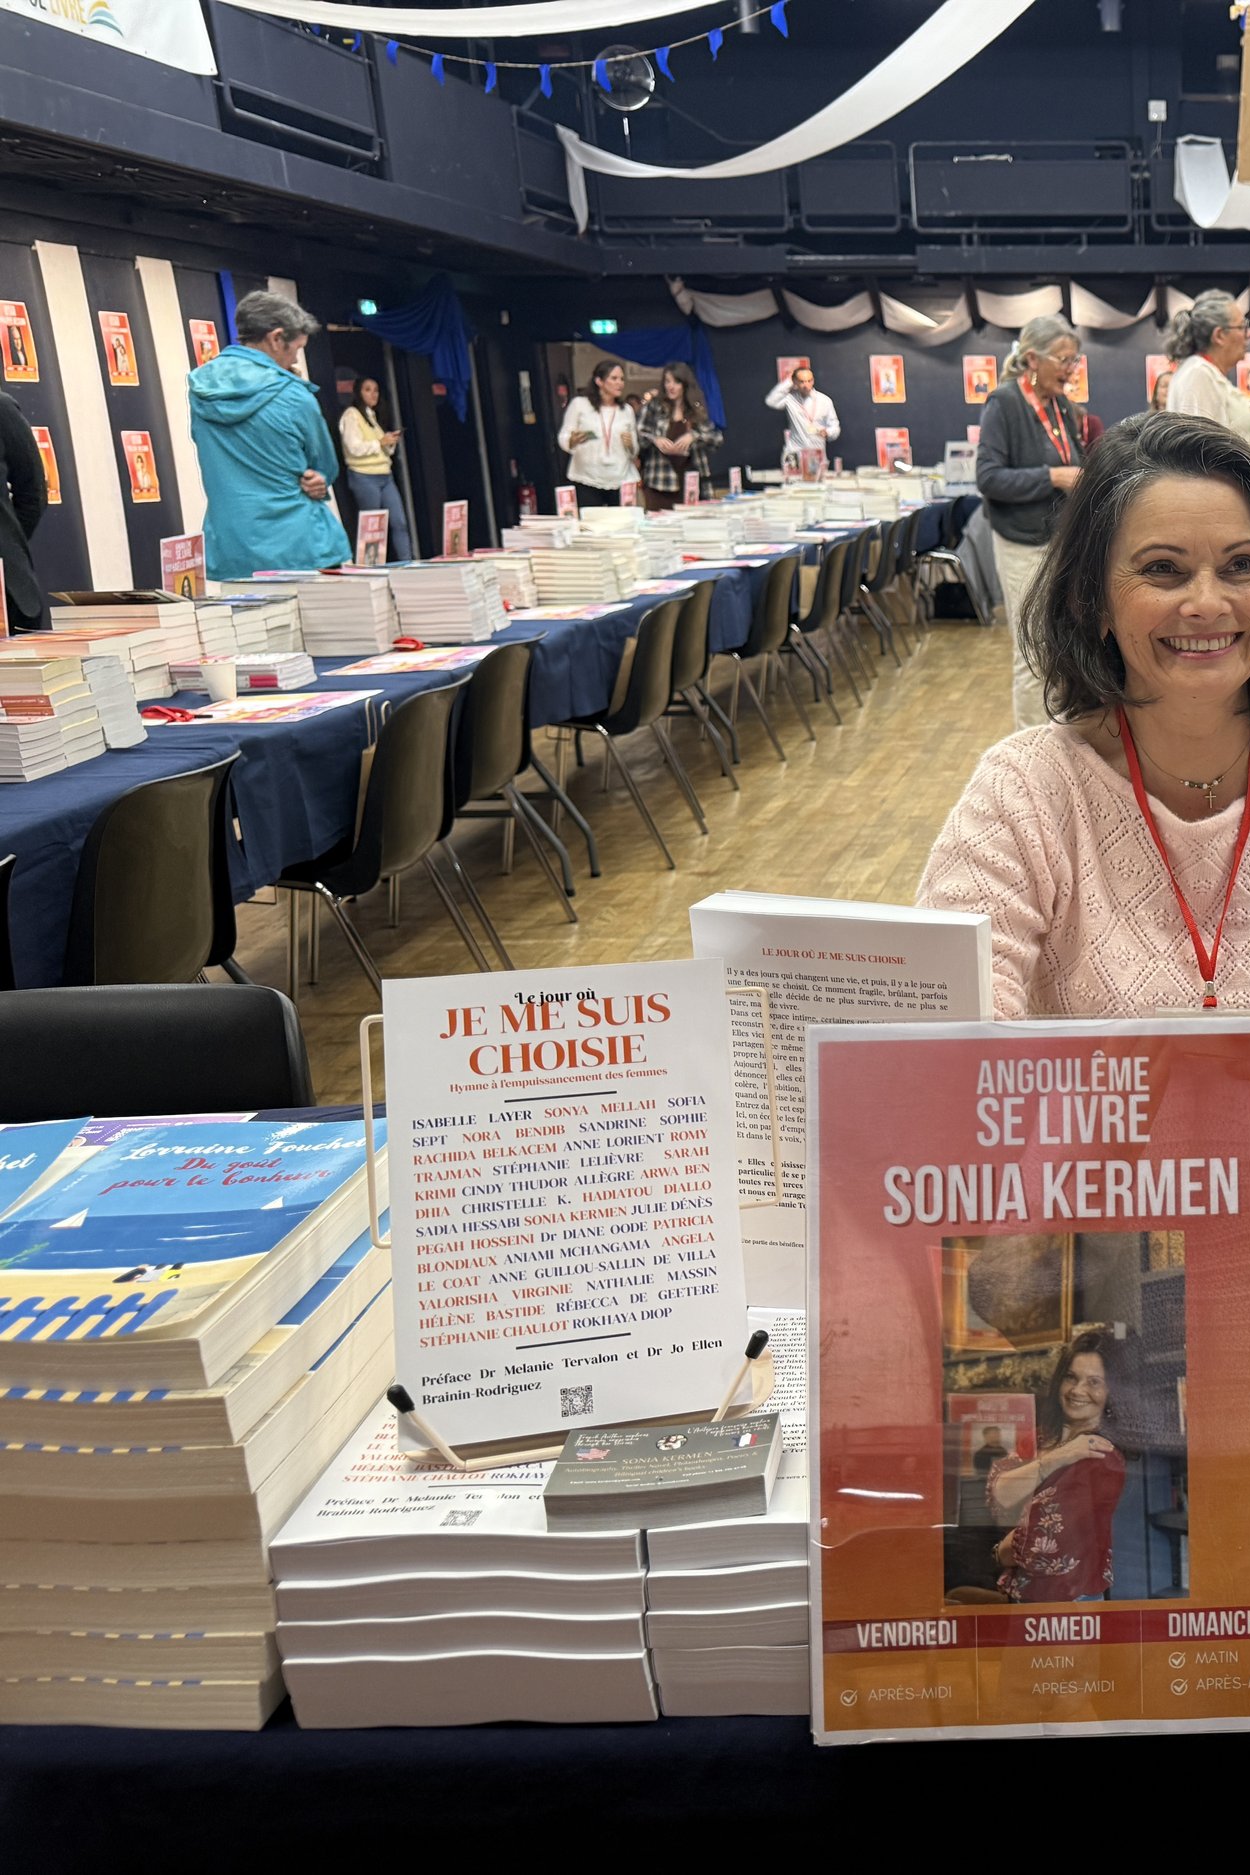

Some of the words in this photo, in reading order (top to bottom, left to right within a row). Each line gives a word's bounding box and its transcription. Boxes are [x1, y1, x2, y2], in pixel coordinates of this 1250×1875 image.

[762, 948, 774, 957] LE
[775, 948, 800, 959] JOUR
[802, 949, 815, 959] OÙ
[817, 951, 828, 960] JE
[830, 952, 844, 961] ME
[845, 953, 866, 962] SUIS
[868, 955, 906, 964] CHOISIE
[515, 991, 536, 1005] Le
[537, 990, 572, 1007] jour
[576, 988, 595, 1001] où
[744, 980, 769, 988] femme
[783, 982, 808, 990] choisit.
[825, 986, 856, 994] moment
[859, 987, 886, 997] fragile,
[888, 988, 917, 999] brûlant,
[921, 991, 948, 1000] parfois
[786, 992, 810, 1001] décide
[813, 994, 822, 1002] de
[838, 996, 854, 1005] plus
[858, 999, 891, 1008] survivre,
[894, 1000, 903, 1008] de
[920, 1001, 936, 1010] plus
[440, 1007, 487, 1039] JE
[501, 1002, 565, 1034] ME
[578, 993, 670, 1028] SUIS
[469, 1034, 647, 1076] CHOISIE
[450, 1080, 489, 1094] Hymne
[492, 1079, 498, 1089] à
[500, 1072, 602, 1089] l'empuissancement
[605, 1070, 623, 1081] des
[626, 1067, 668, 1079] femmes
[976, 1050, 1150, 1095] ANGOULÊME
[412, 1114, 476, 1130] ISABELLE
[489, 1110, 532, 1124] LAYER
[544, 1105, 588, 1118] SONYA
[601, 1100, 656, 1113] MELLAH
[668, 1095, 705, 1108] SOFIA
[976, 1096, 1025, 1147] SE
[1039, 1094, 1151, 1144] LIVRE
[413, 1135, 447, 1148] SEPT
[462, 1130, 501, 1144] NORA
[516, 1124, 565, 1138] BENDIB
[579, 1118, 646, 1133] SANDRINE
[660, 1112, 707, 1126] SOPHIE
[120, 1142, 258, 1160] Lorraine
[263, 1136, 366, 1155] Fouchet
[414, 1150, 476, 1165] RACHIDA
[483, 1143, 557, 1159] BELKACEM
[563, 1138, 600, 1152] ANNE
[607, 1133, 664, 1148] LORIENT
[670, 1129, 708, 1142] ROMY
[173, 1158, 217, 1171] Du
[98, 1178, 177, 1196] pour
[187, 1172, 212, 1186] le
[220, 1168, 331, 1188] bonheur
[883, 1162, 1028, 1225] SONIA
[1043, 1157, 1240, 1219] KERMEN
[416, 1224, 458, 1238] SADIA
[462, 1218, 520, 1233] HESSABI
[524, 1213, 566, 1228] SONIA
[570, 1206, 627, 1222] KERMEN
[631, 1201, 667, 1215] JULIE
[671, 1196, 712, 1211] DÉNÈS
[419, 1311, 475, 1329] HÉLÈNE
[486, 1305, 545, 1321] BASTIDE
[556, 1296, 619, 1313] RÉBECCA
[630, 1291, 647, 1304] DE
[658, 1283, 718, 1300] GEETERE
[419, 1328, 500, 1349] STÉPHANIE
[503, 1320, 569, 1338] CHAULOT
[572, 1313, 637, 1329] ROKHAYA
[641, 1308, 672, 1321] DIOP
[422, 1371, 471, 1387] Préface
[480, 1368, 496, 1379] Dr
[504, 1360, 554, 1376] Melanie
[562, 1352, 618, 1368] Tervalon
[627, 1350, 638, 1360] et
[647, 1346, 663, 1357] Dr
[671, 1344, 683, 1354] Jo
[692, 1338, 722, 1351] Ellen
[422, 1380, 541, 1405] Brainin-Rodriguez
[623, 1456, 659, 1465] SONIA
[662, 1451, 713, 1462] KERMEN
[856, 1619, 957, 1649] VENDREDI
[1024, 1615, 1100, 1642] SAMEDI
[1031, 1656, 1074, 1669] MATIN
[1195, 1651, 1239, 1664] MATIN
[868, 1684, 952, 1702] APRÈS-MIDI
[1032, 1677, 1115, 1695] APRÈS-MIDI
